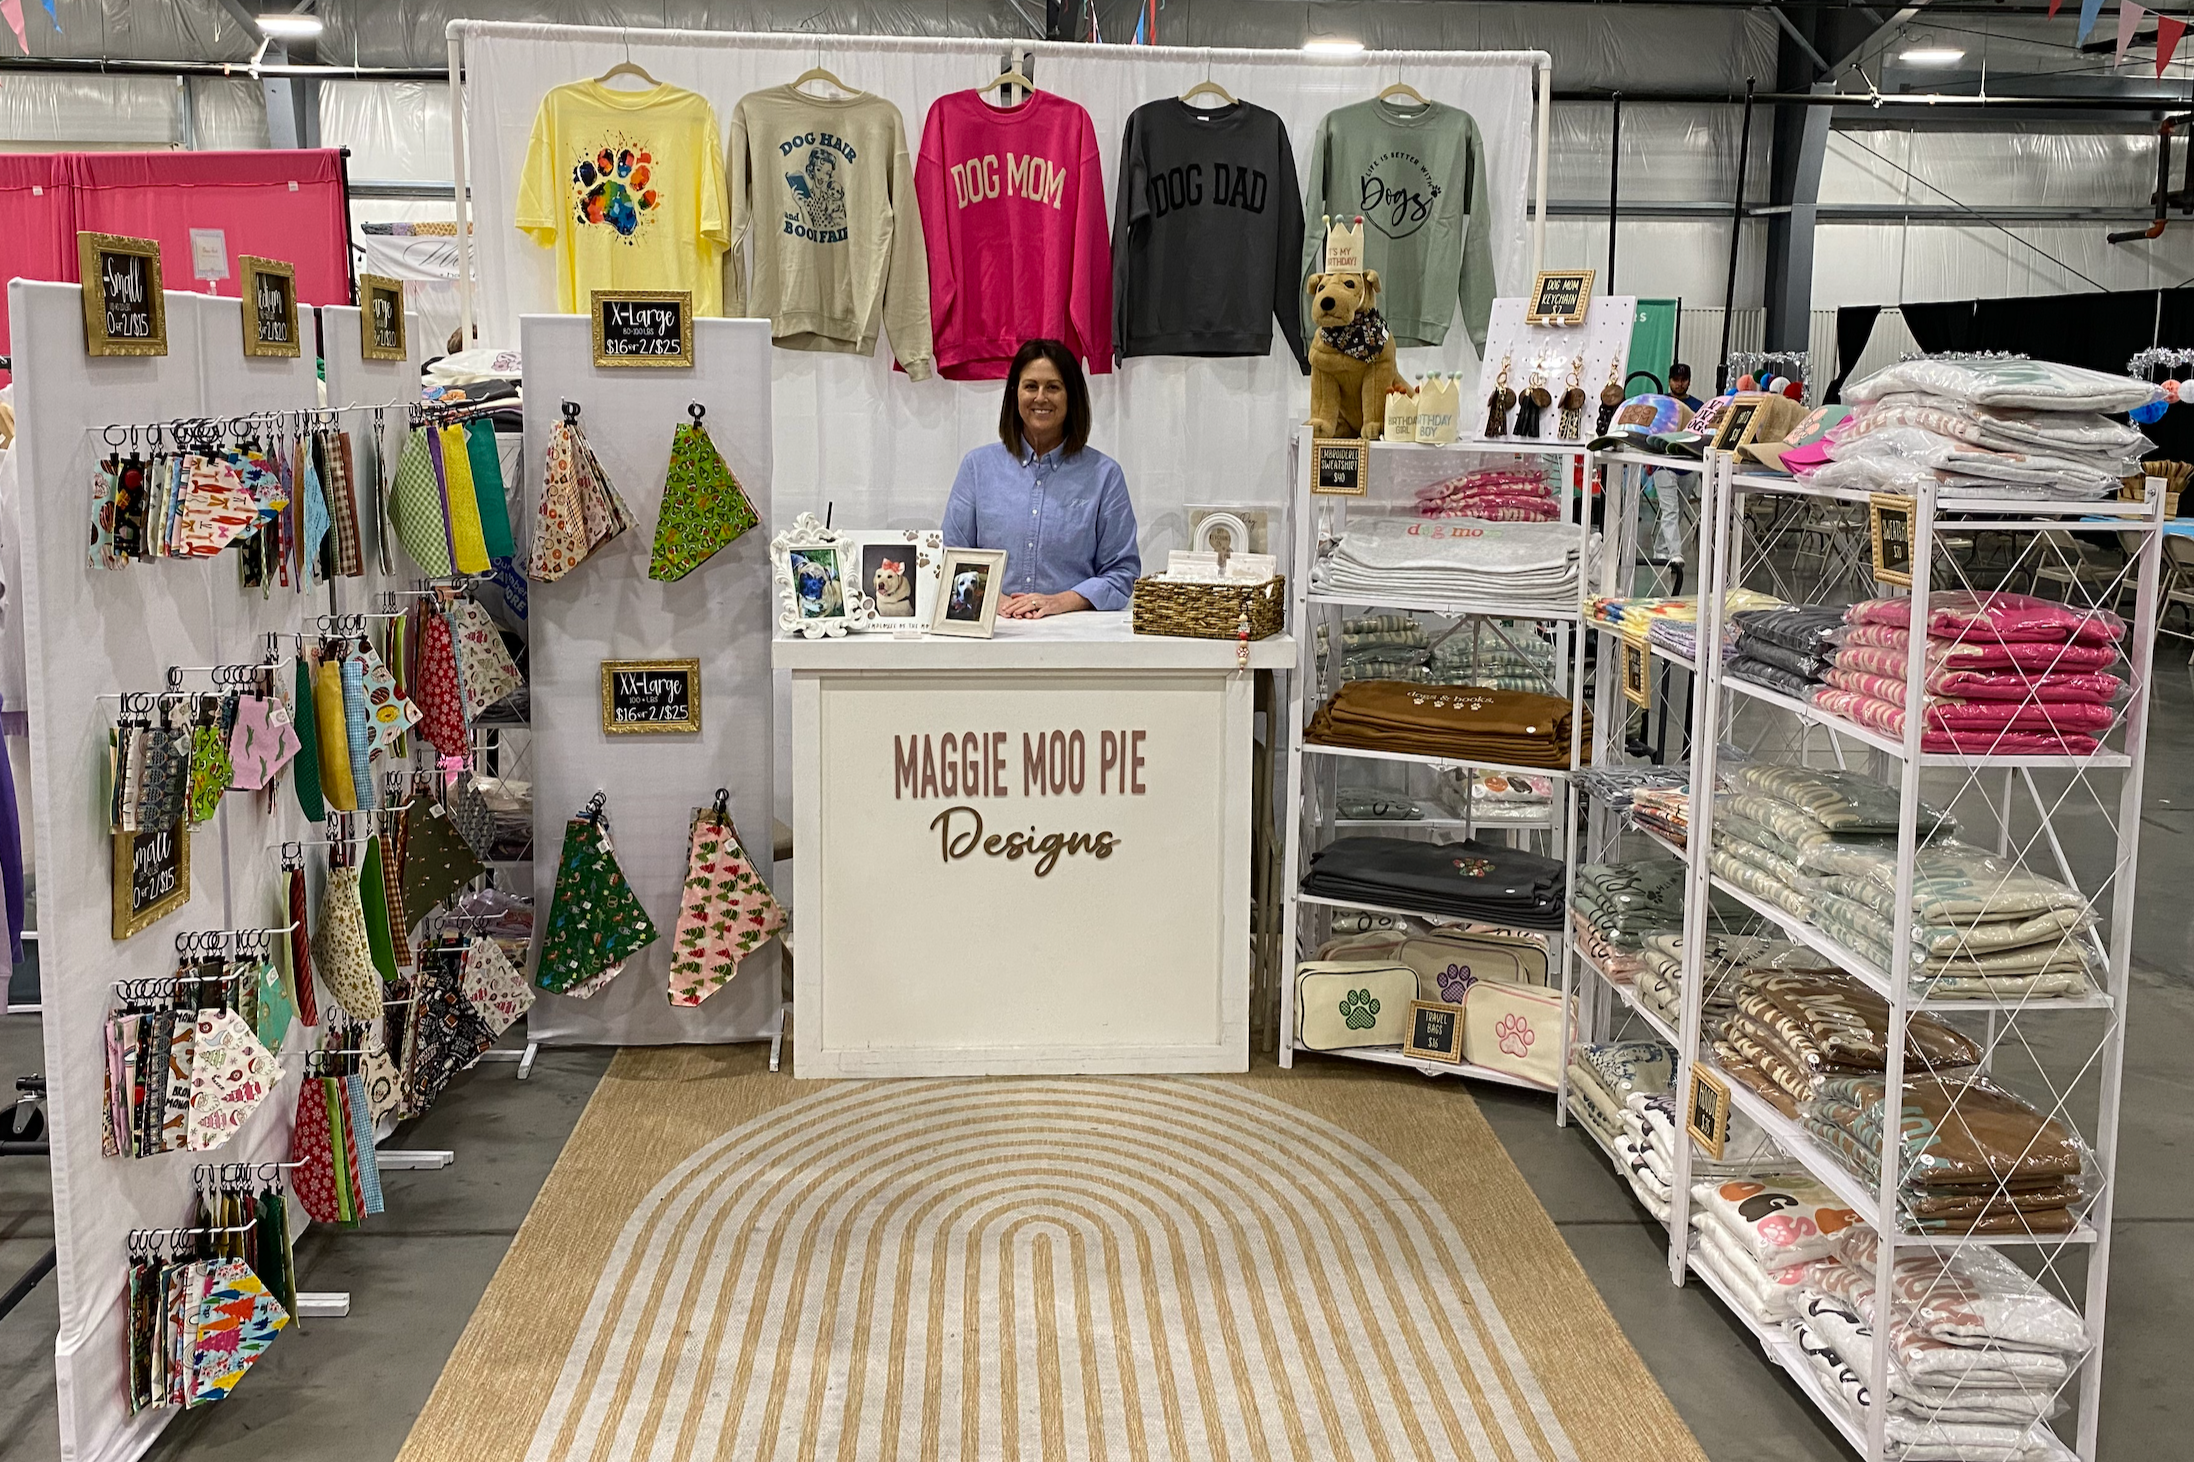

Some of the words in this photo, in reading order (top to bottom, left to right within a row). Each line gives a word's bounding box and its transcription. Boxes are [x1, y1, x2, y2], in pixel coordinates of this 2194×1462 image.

[779, 132, 816, 157] DOG
[819, 132, 857, 164] HAIR
[1366, 160, 1380, 177] LIFE
[1380, 153, 1389, 162] IS
[1390, 151, 1420, 166] BETTER
[1420, 164, 1433, 188] WITH
[950, 154, 1000, 210] DOG
[1006, 152, 1067, 211] MOM
[1151, 163, 1202, 219] DOG
[1212, 162, 1267, 215] DAD
[1360, 175, 1433, 227] Dogs
[784, 211, 800, 222] and
[1327, 256, 1357, 266] RTHDAY!
[1547, 279, 1561, 291] DOG
[1562, 279, 1580, 291] MOM
[1541, 293, 1578, 305] KEYCHAIN
[122, 312, 149, 337] 2/$15
[611, 301, 675, 337] X-Large
[605, 338, 629, 355] $16
[639, 338, 681, 355] 2/$25
[1388, 415, 1417, 426] BIRTHDA
[1395, 425, 1411, 435] GIRL
[1420, 426, 1438, 437] BOY
[1321, 459, 1358, 471] SWEATSHIRT
[1407, 523, 1445, 539] dog
[619, 671, 682, 704] XX-Large
[1406, 690, 1438, 701] dogs
[1439, 694, 1450, 702] &
[615, 706, 638, 722] $16
[648, 704, 689, 721] 2/$25
[894, 731, 1008, 800] MAGGIE
[1022, 729, 1086, 797] MOO
[1100, 729, 1147, 795] PIE
[929, 805, 1122, 878] Designs
[133, 831, 172, 874] mall
[149, 866, 176, 900] 2/$15
[1425, 1011, 1448, 1025] TRAVEL
[1426, 1022, 1443, 1036] BAGS
